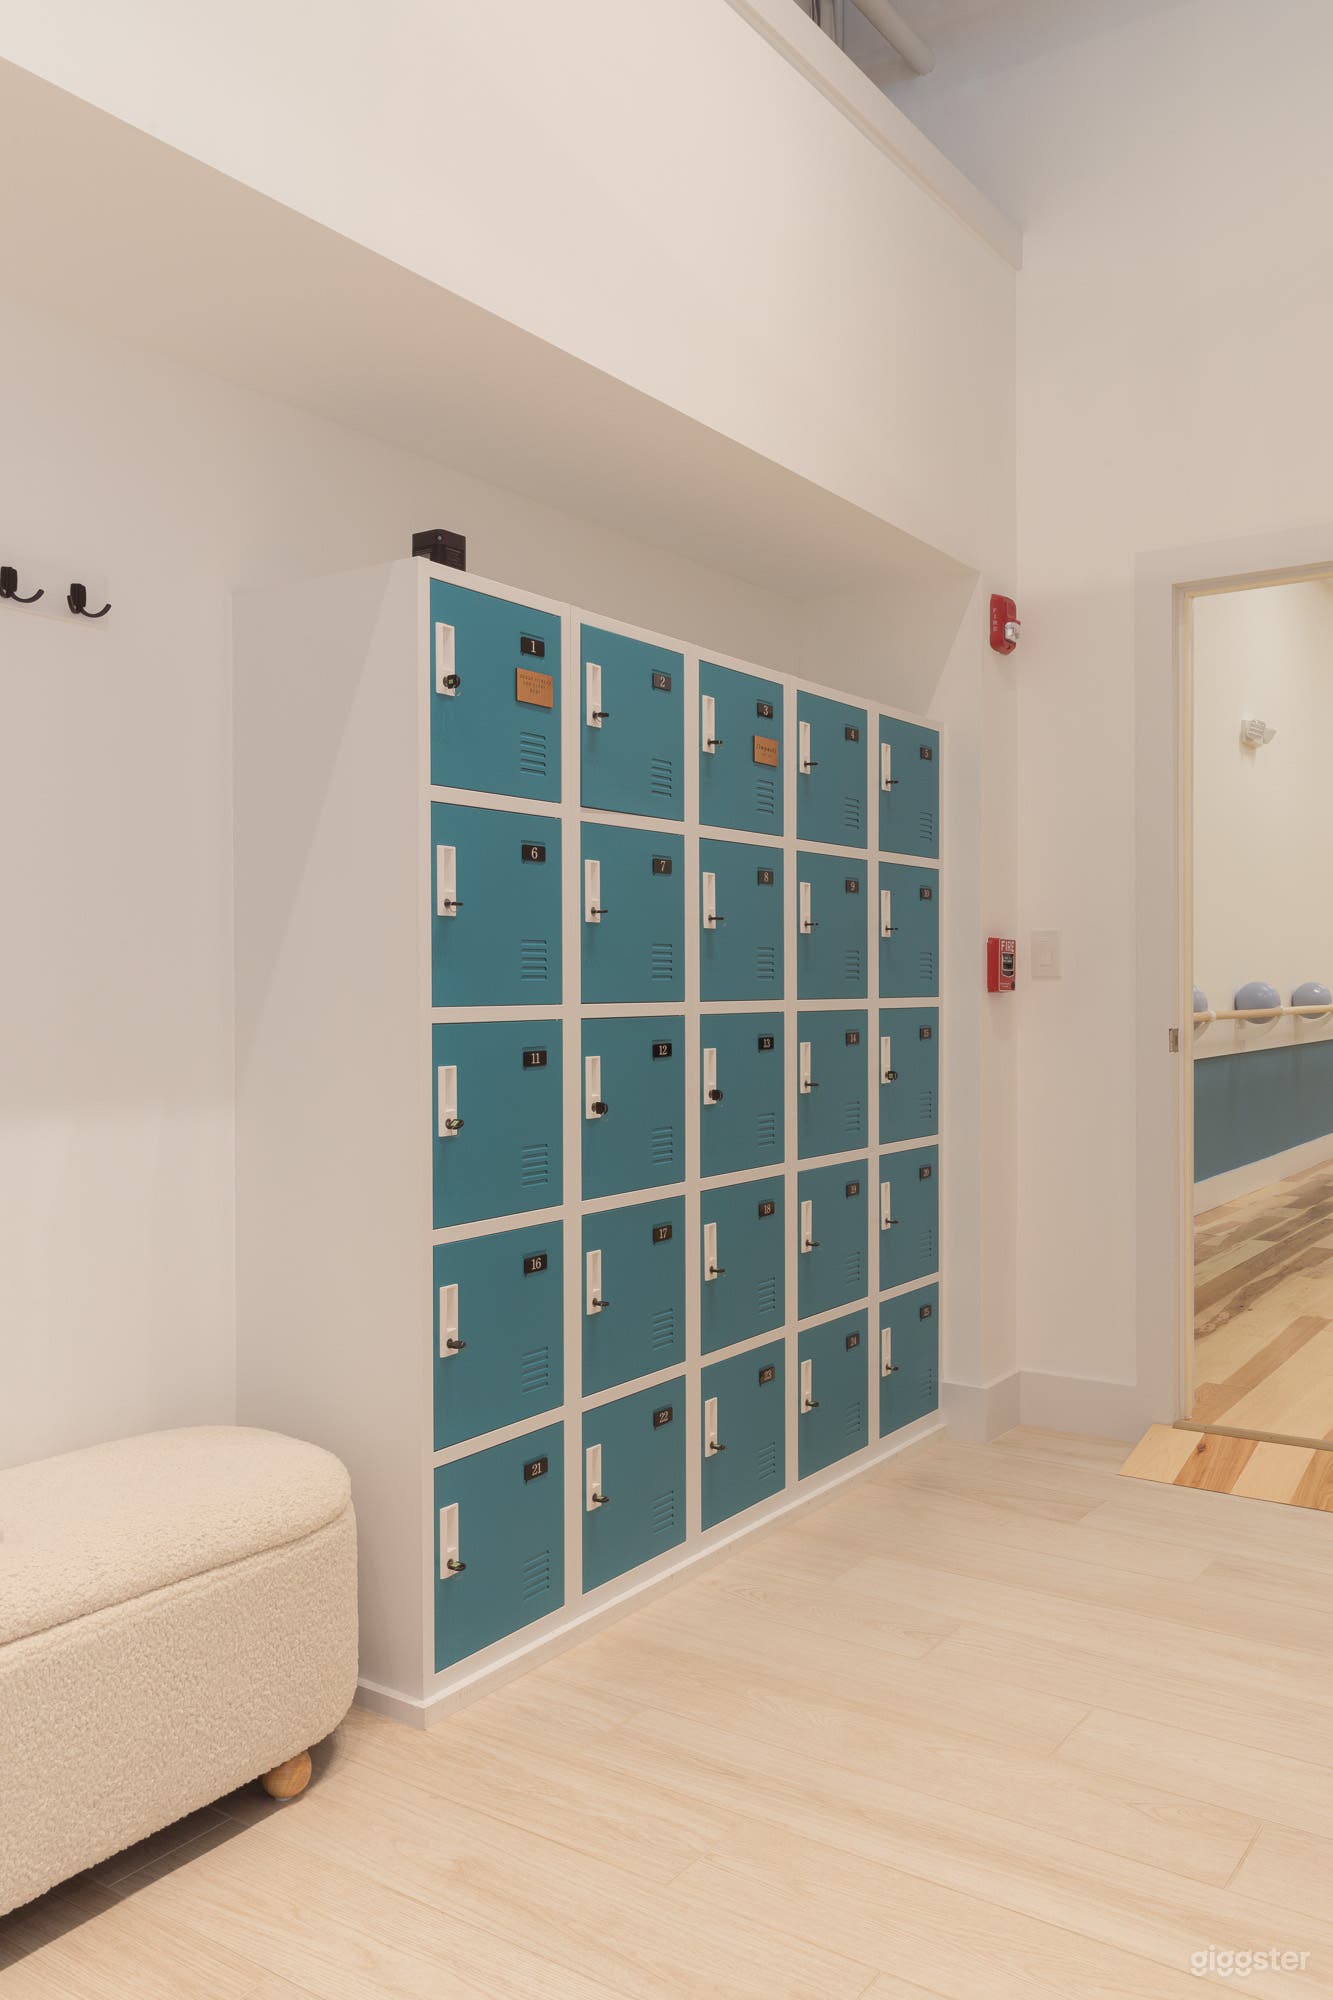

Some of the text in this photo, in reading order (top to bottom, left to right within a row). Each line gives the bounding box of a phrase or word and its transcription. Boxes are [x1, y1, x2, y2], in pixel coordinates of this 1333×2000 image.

[531, 640, 536, 653] 1
[660, 676, 665, 688] 2
[763, 706, 768, 716] 3
[531, 847, 538, 859] 6
[660, 861, 666, 872] 7
[764, 872, 768, 882] 8
[1001, 940, 1015, 952] FIRE
[763, 1039, 771, 1048] 13
[659, 1045, 667, 1055] 12
[531, 1053, 540, 1064] 11
[764, 1204, 771, 1214] 18
[659, 1228, 668, 1239] 17
[531, 1258, 542, 1270] 16
[659, 1411, 669, 1424] 22
[532, 1463, 542, 1476] 21
